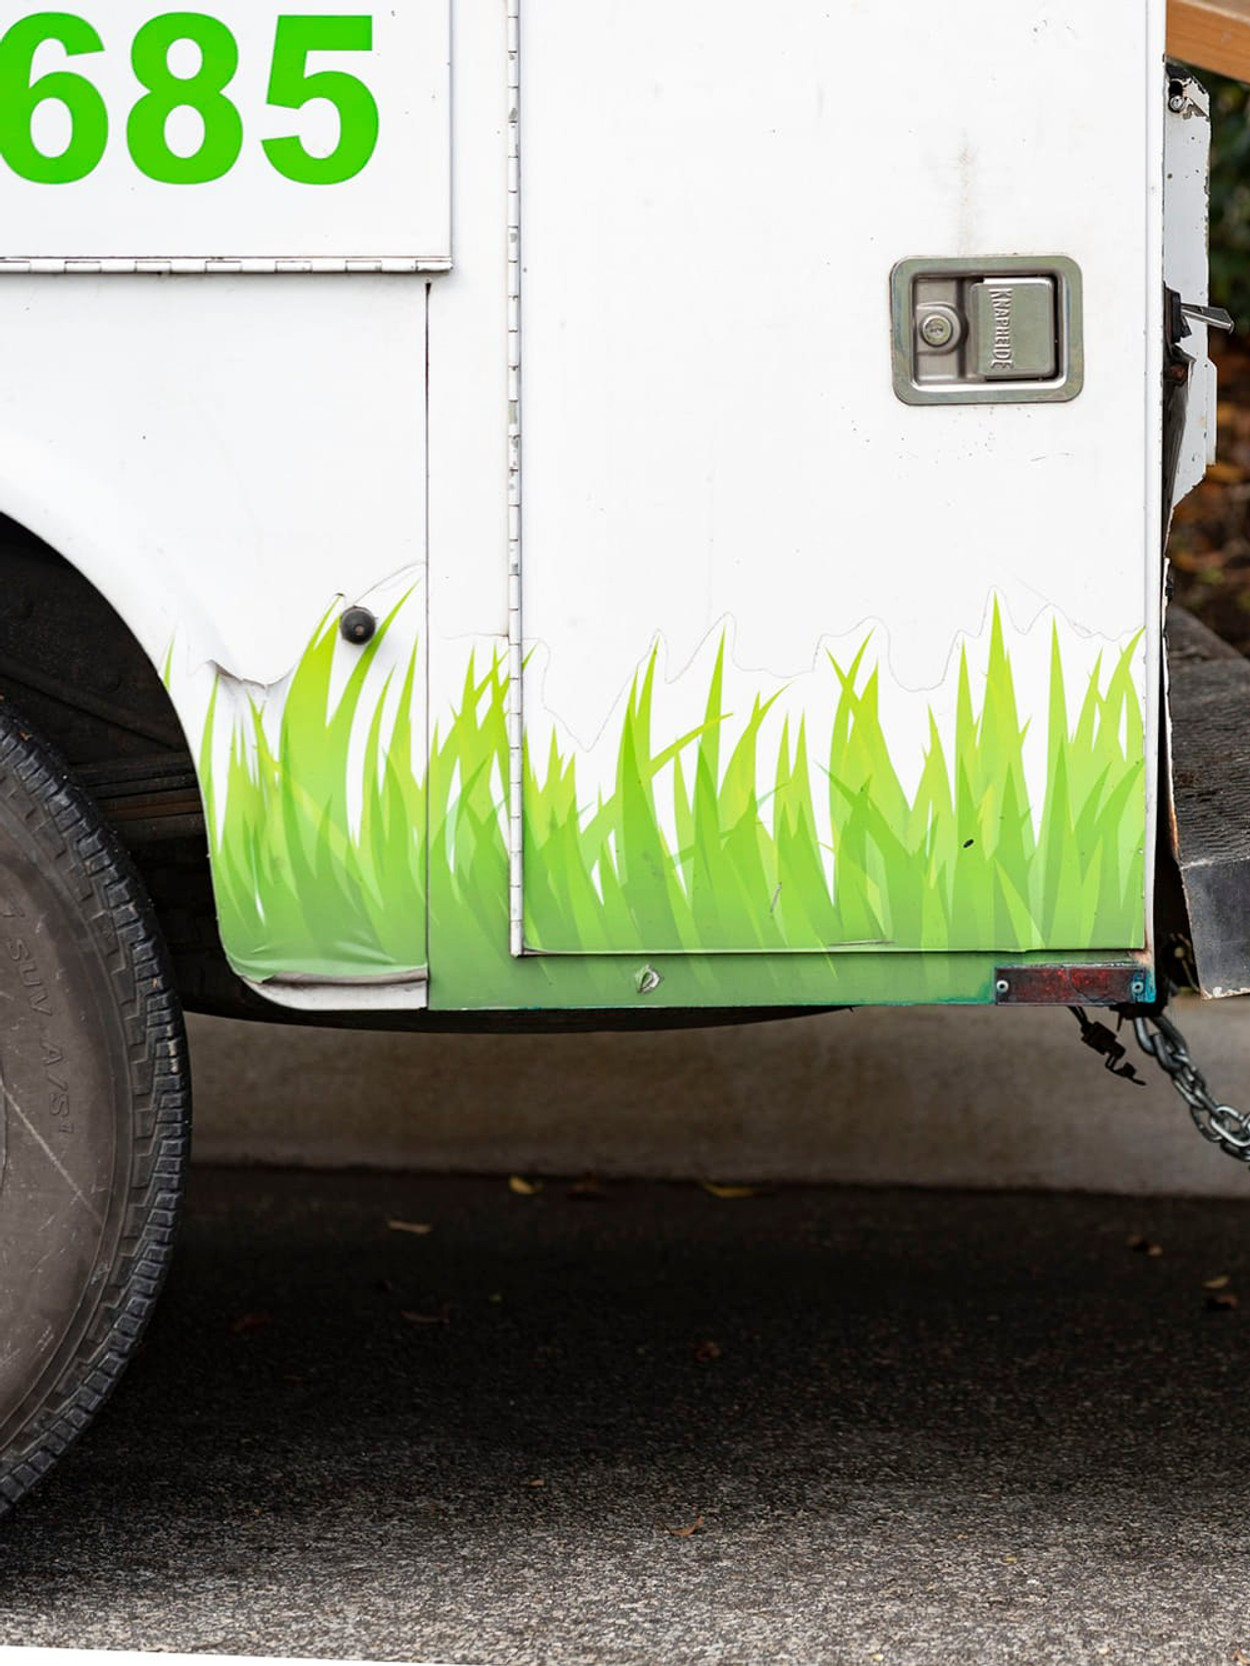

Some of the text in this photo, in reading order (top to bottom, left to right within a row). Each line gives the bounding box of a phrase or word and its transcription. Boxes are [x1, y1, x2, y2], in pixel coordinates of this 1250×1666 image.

[0, 12, 379, 185] 685
[988, 287, 1014, 370] KNAPHEIDE
[6, 937, 54, 1016] SUV
